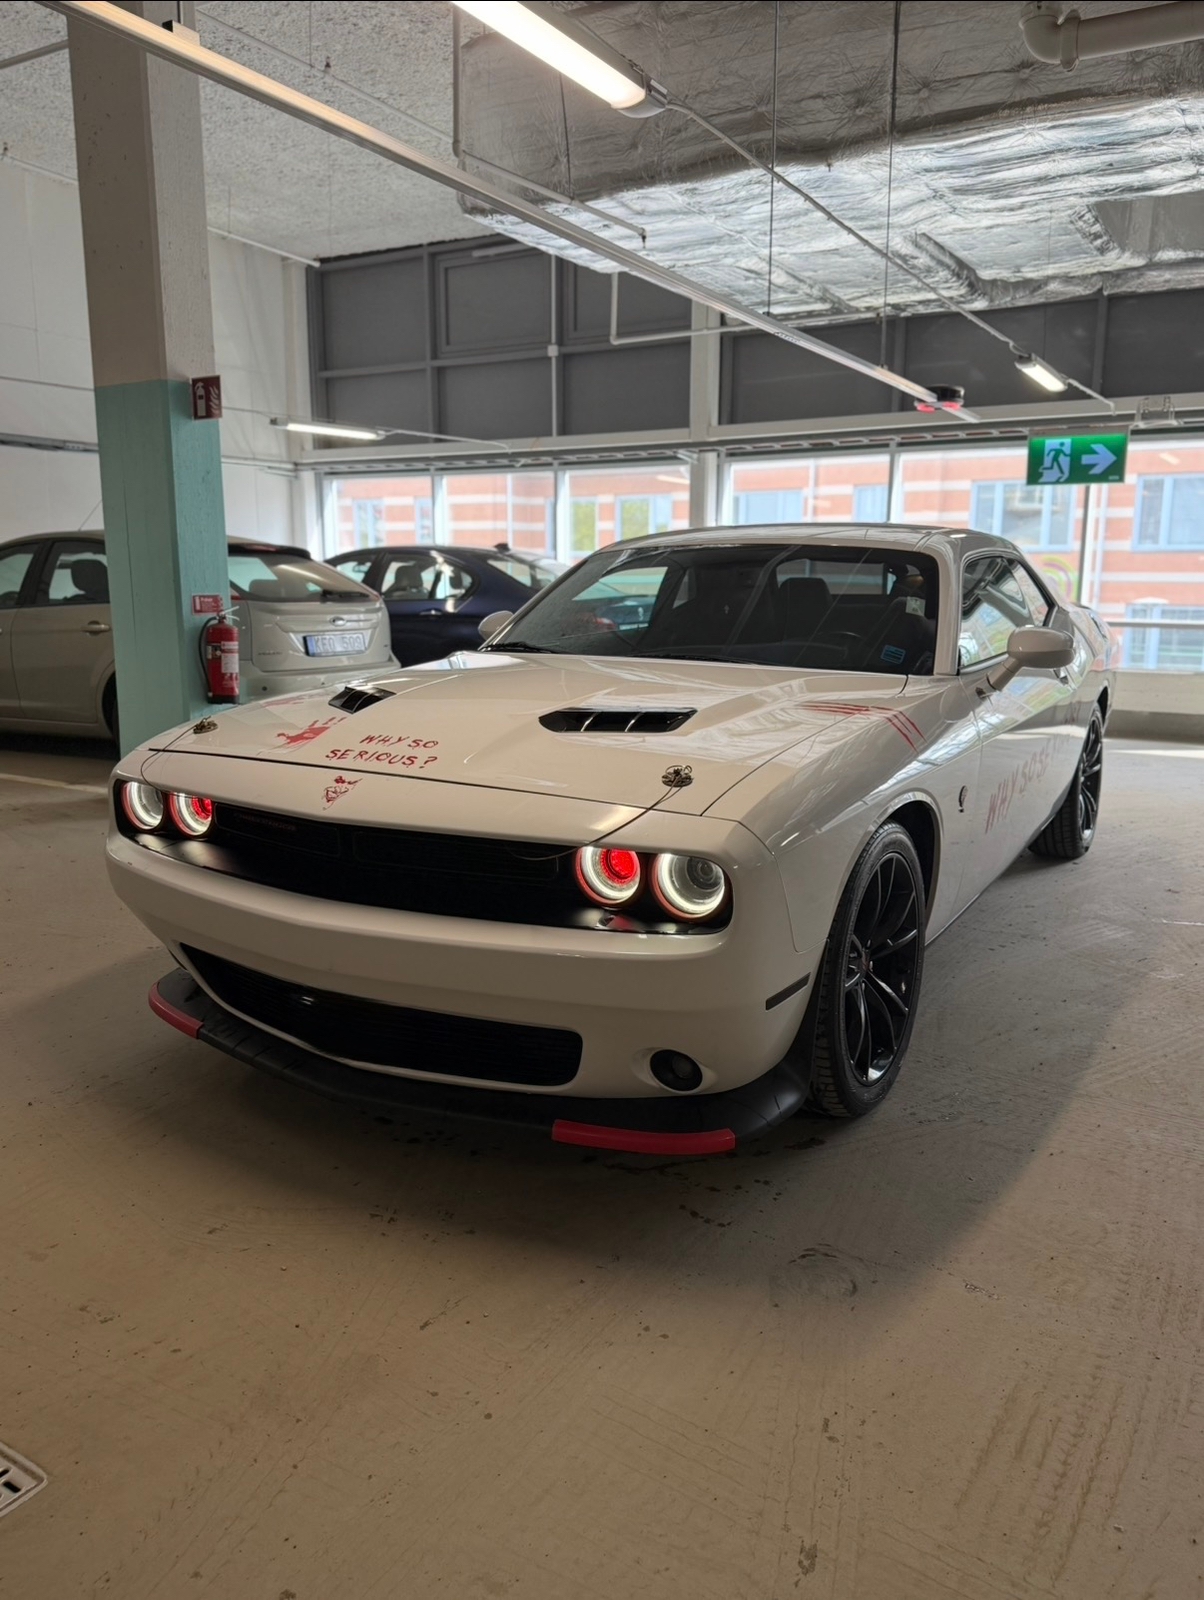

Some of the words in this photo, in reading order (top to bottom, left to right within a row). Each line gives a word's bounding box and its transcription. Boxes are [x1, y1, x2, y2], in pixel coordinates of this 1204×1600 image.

[342, 635, 363, 650] 509
[359, 734, 410, 747] WHY
[407, 739, 439, 750] SO
[325, 748, 438, 769] SERIOUS?
[984, 763, 1020, 835] WHY
